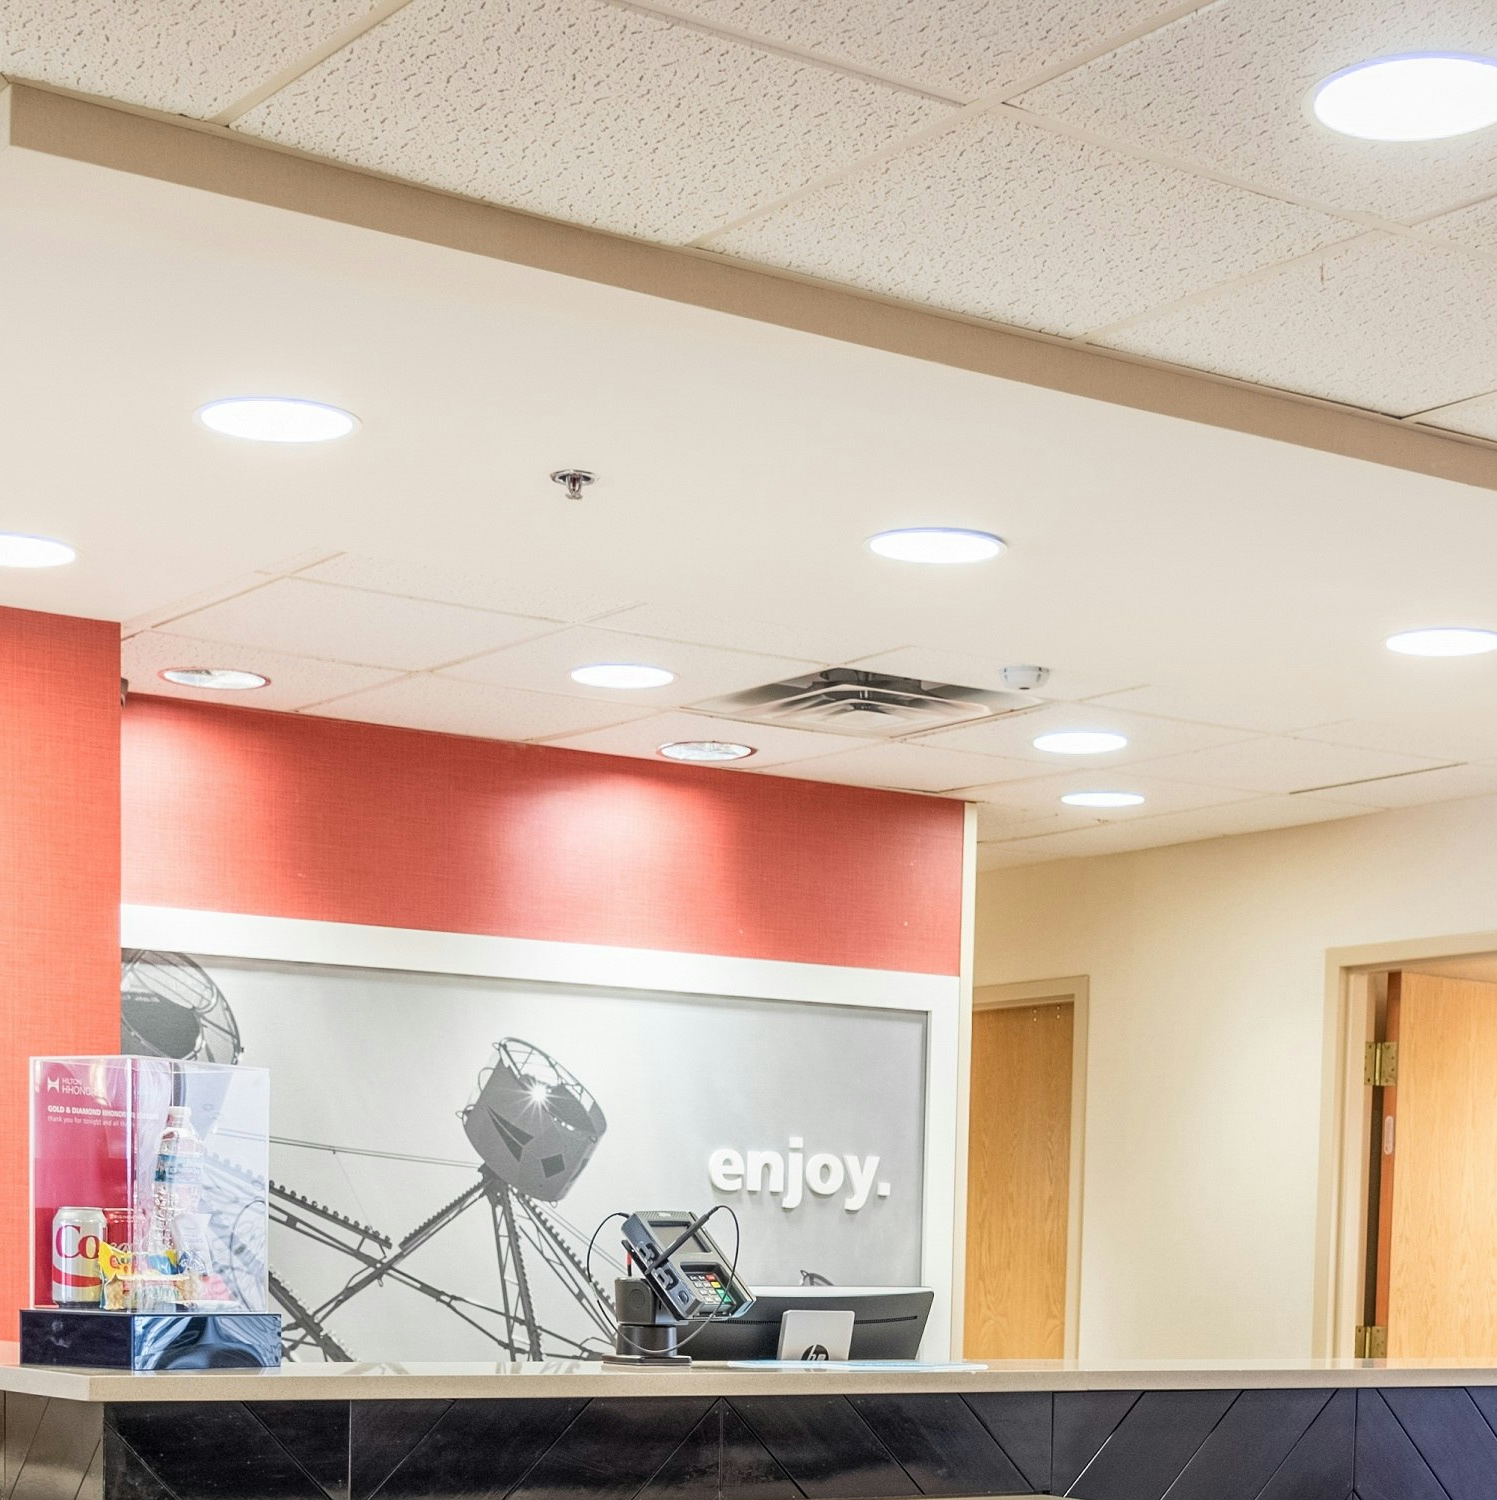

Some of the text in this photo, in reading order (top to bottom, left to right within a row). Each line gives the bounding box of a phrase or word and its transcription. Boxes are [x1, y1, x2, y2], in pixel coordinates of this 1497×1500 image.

[62, 1077, 82, 1086] HILTON
[62, 1085, 100, 1097] HHONOR
[47, 1105, 65, 1113] GOLD
[65, 1106, 71, 1114] &
[71, 1107, 101, 1116] DIAMOND
[708, 1136, 891, 1211] enjoy.
